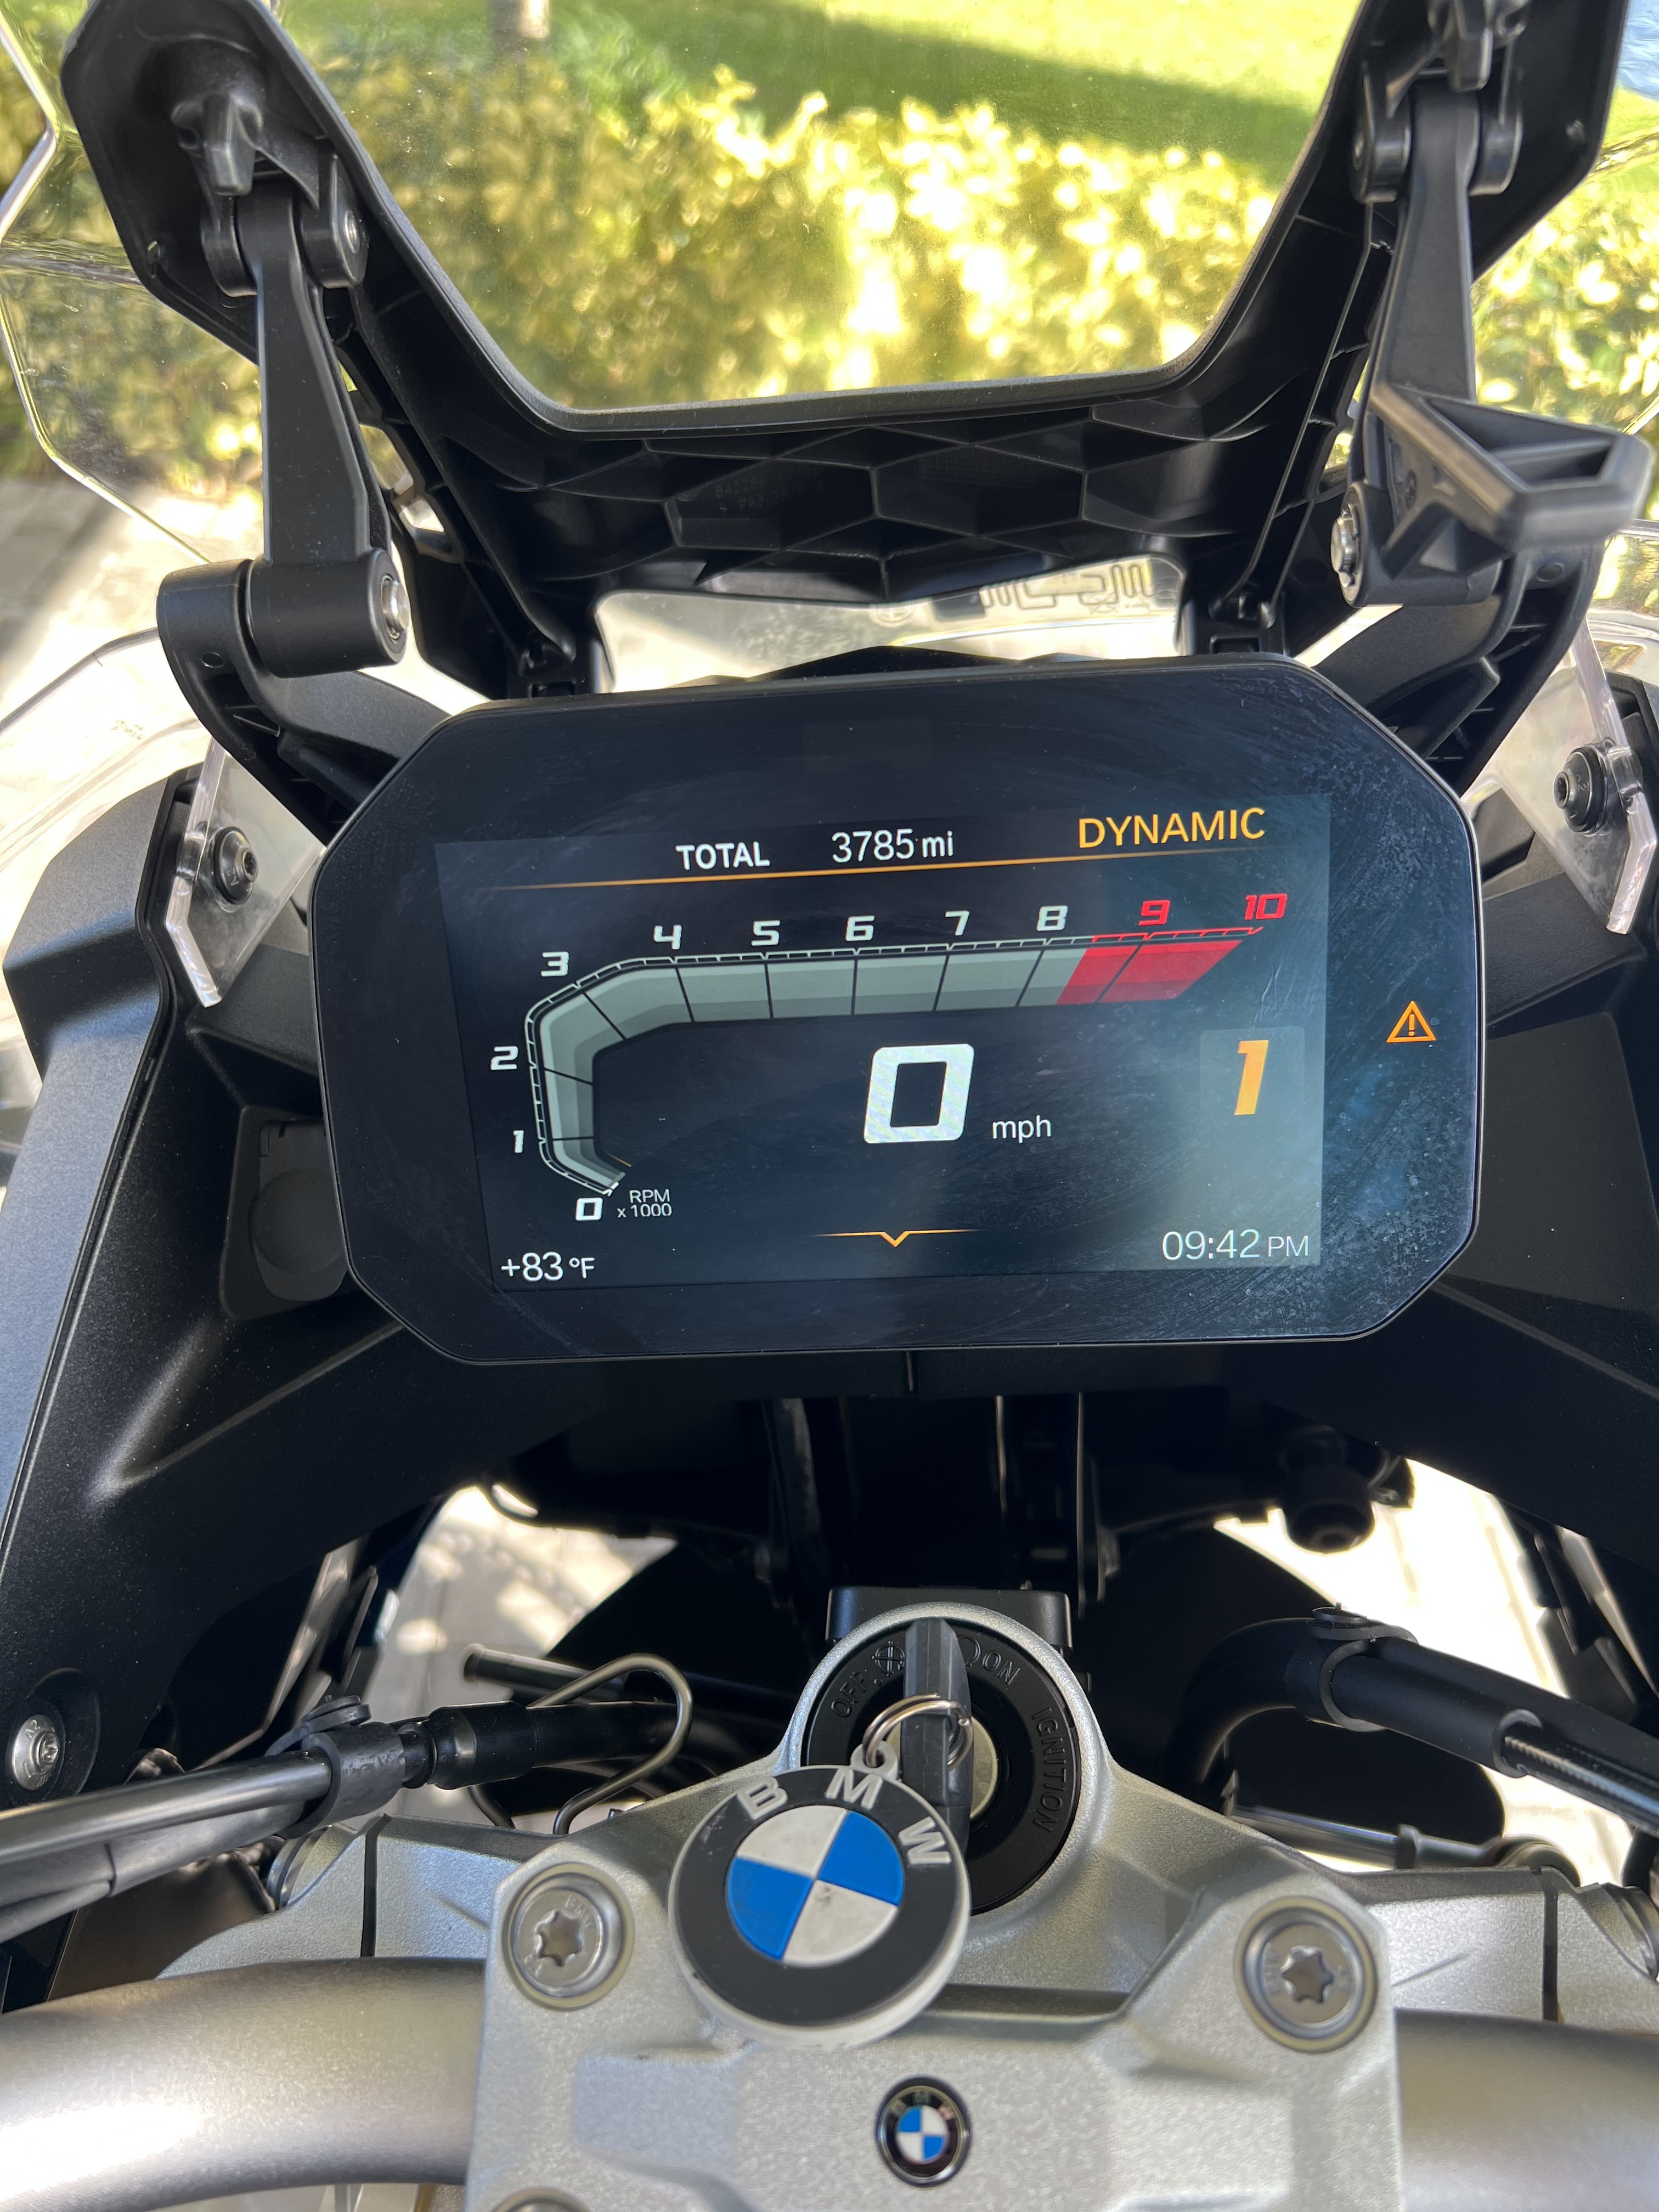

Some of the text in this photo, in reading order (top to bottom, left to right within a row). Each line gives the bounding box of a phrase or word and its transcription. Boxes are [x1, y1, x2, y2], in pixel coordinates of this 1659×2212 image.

[1080, 808, 1264, 848] DYNAMIC
[676, 829, 953, 870] TOTAL 3785 mi
[1037, 906, 1068, 931] 8
[1139, 900, 1170, 926] 9
[1245, 894, 1287, 919] 10
[752, 921, 780, 946] 5
[846, 916, 874, 941] 6
[946, 911, 969, 935] 7
[654, 925, 682, 949] 4
[541, 952, 569, 977] 3
[491, 1046, 518, 1070] 2
[1234, 1040, 1268, 1115] 1
[864, 1044, 974, 1143] 0
[514, 1130, 524, 1153] 1
[993, 1115, 1051, 1143] mph
[630, 1189, 670, 1203] RPM
[575, 1198, 602, 1221] 0
[1163, 1229, 1308, 1260] 09:42 PM
[981, 1651, 1021, 1686] ON
[830, 1669, 868, 1718] OFF
[1031, 1707, 1068, 1832] IGNITION
[737, 1767, 951, 1865] BMW
